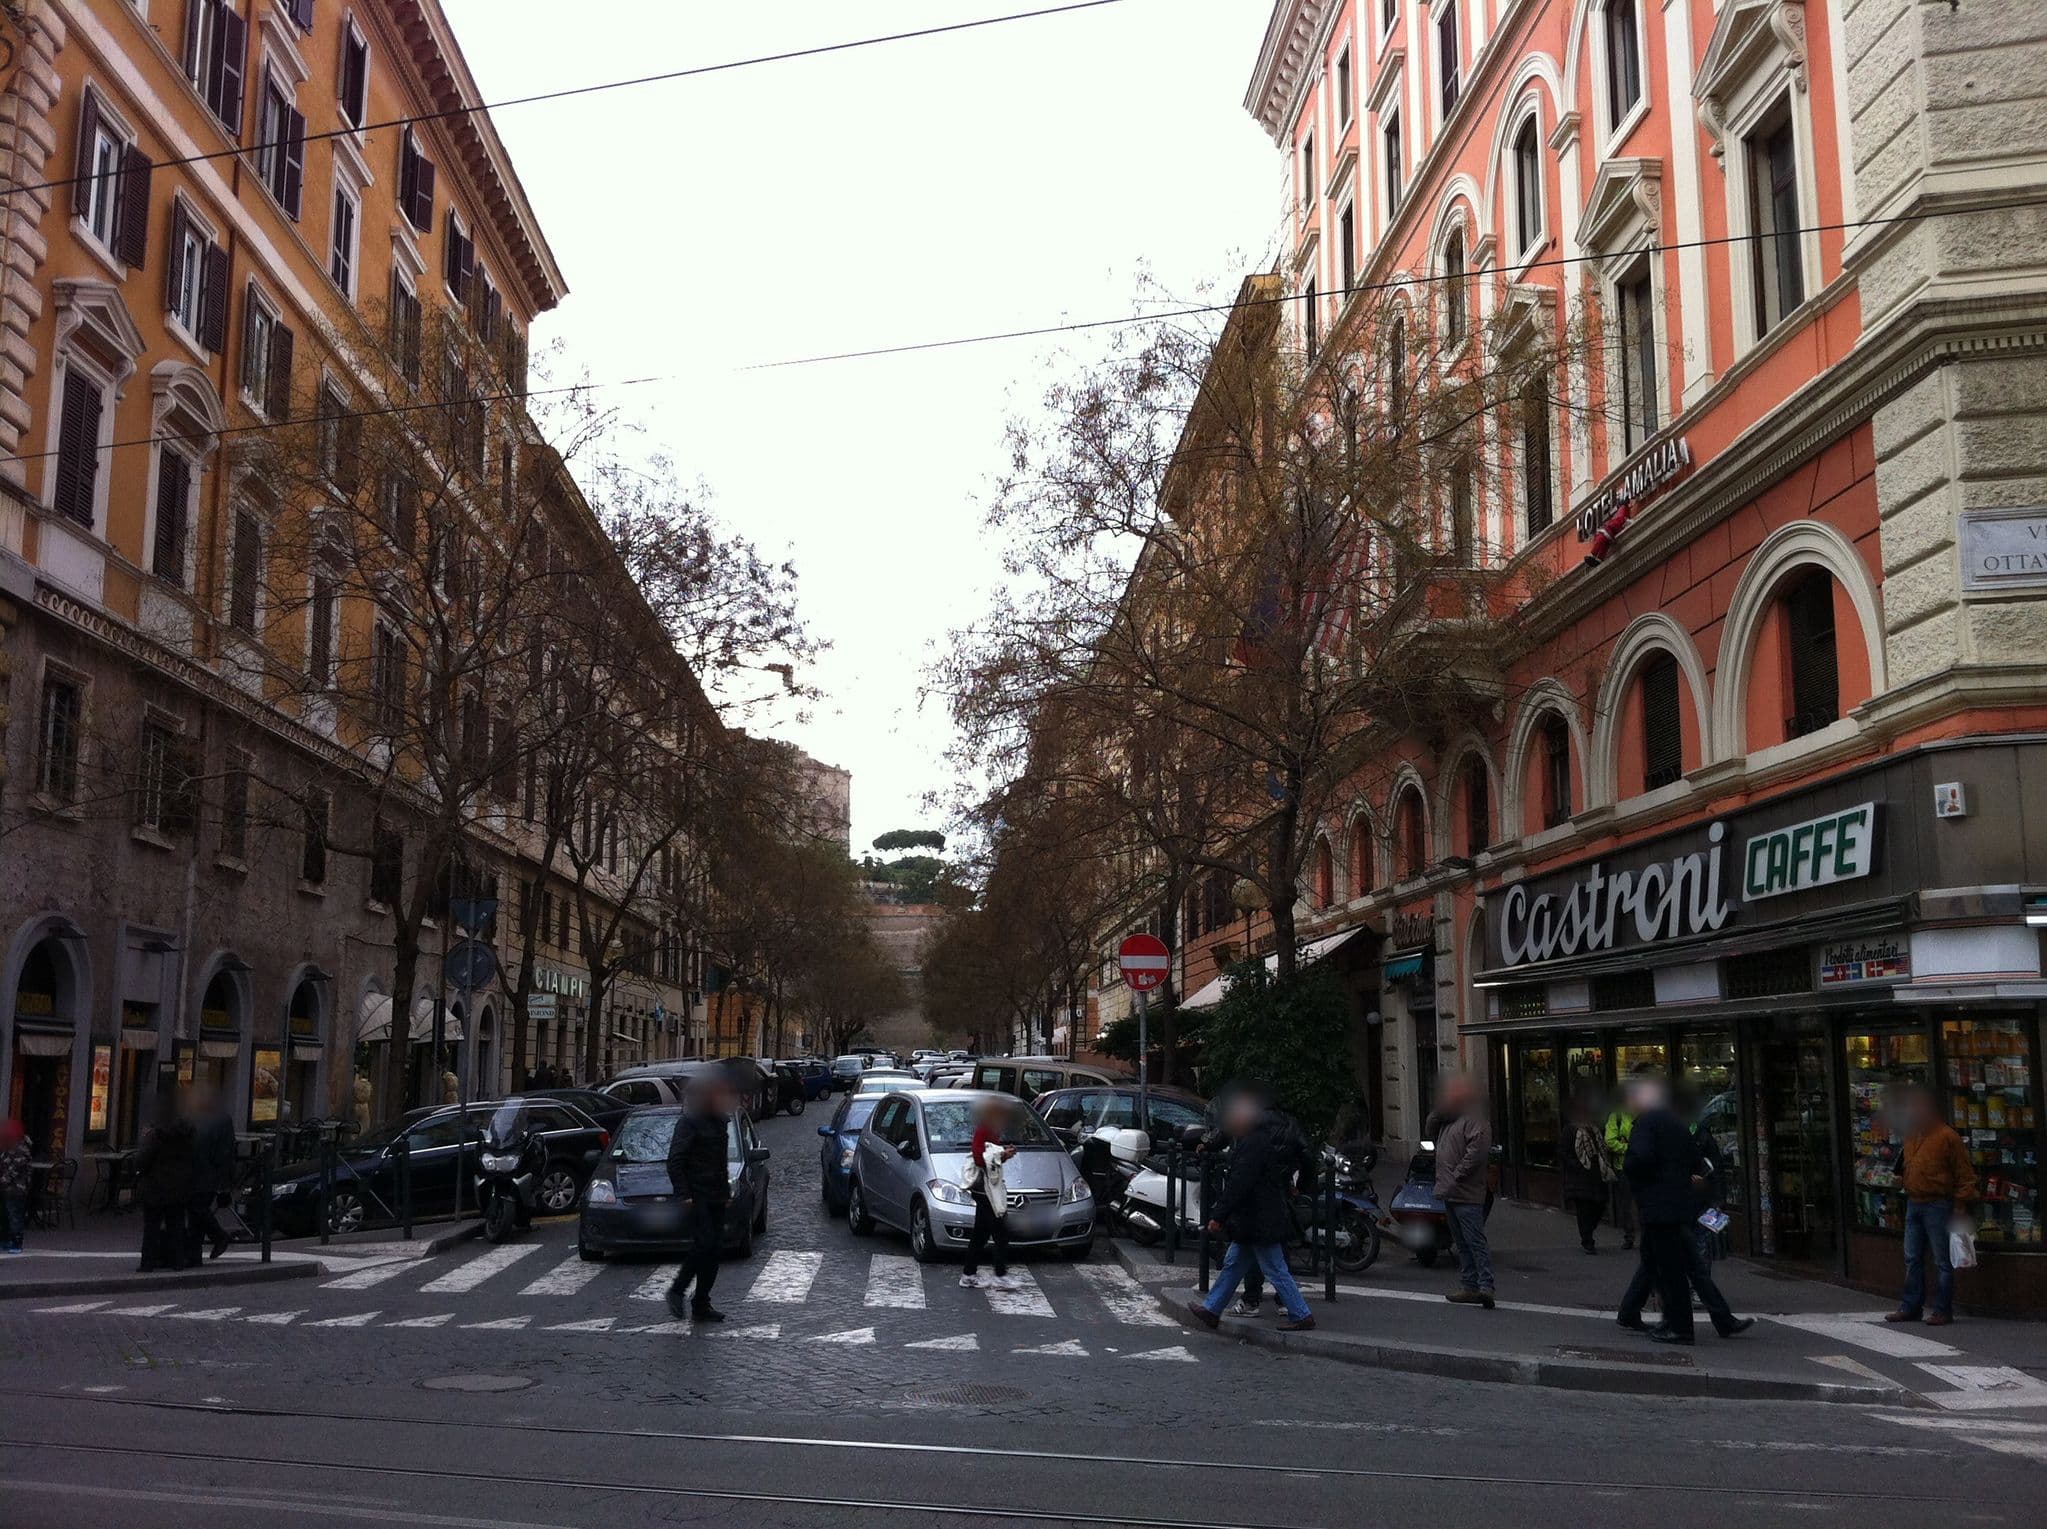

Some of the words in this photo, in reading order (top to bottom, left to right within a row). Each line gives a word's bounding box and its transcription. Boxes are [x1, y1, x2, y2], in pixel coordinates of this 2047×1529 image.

[1576, 488, 1618, 536] HOTEL
[1623, 438, 1678, 501] AMALIA
[1500, 821, 1730, 967] Castroni
[536, 966, 584, 998] CIAMPI
[1855, 939, 1899, 962] alimentari
